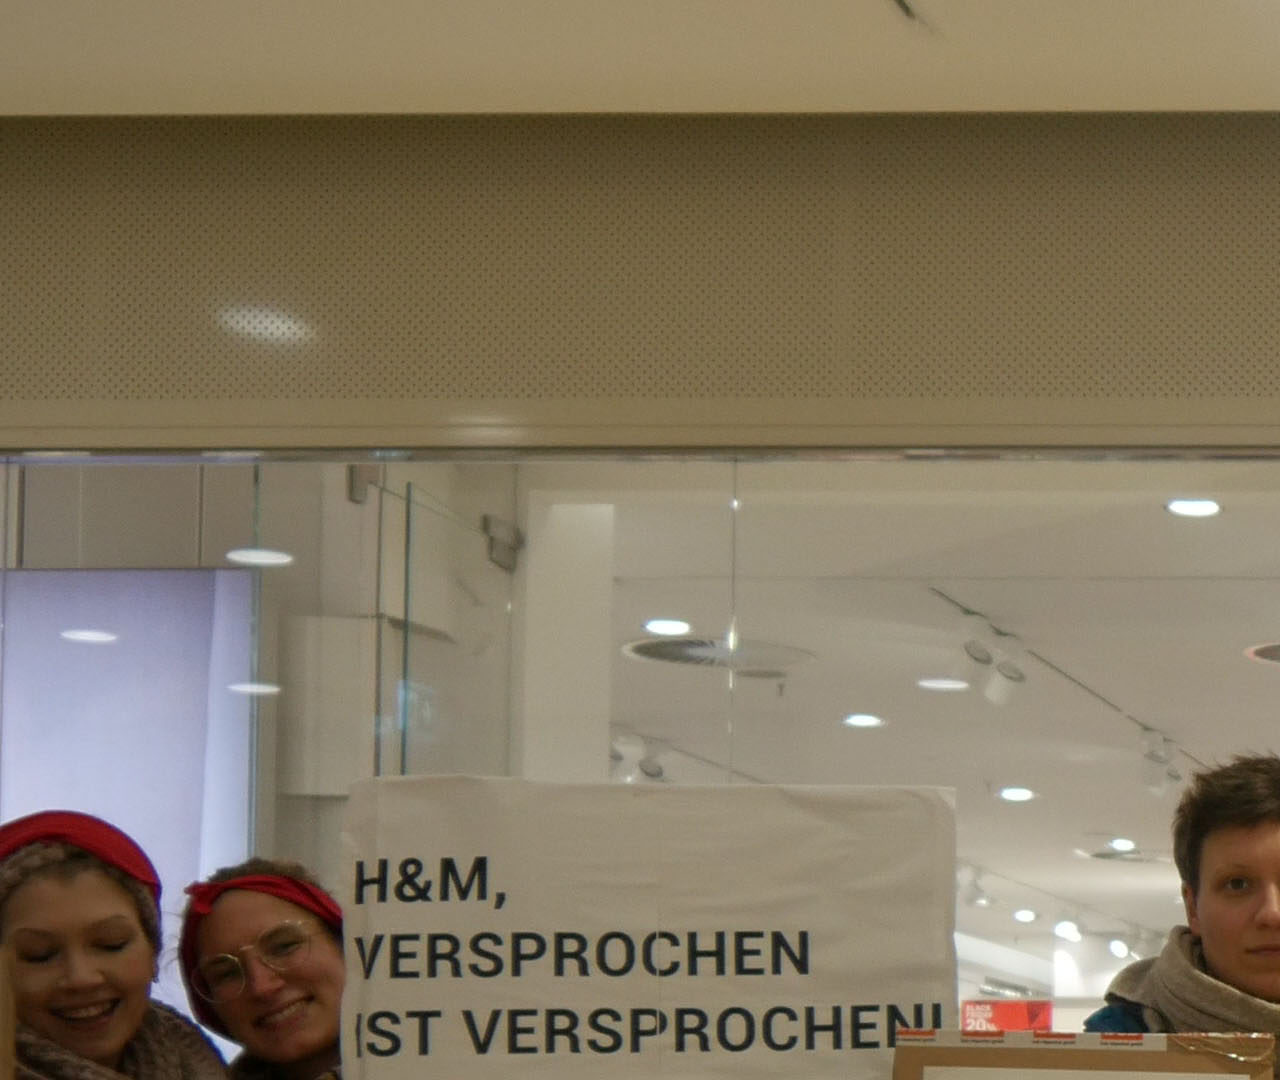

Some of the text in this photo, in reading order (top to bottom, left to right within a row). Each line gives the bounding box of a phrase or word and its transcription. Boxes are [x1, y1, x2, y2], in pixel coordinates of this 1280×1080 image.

[353, 856, 506, 910] H&M,
[354, 930, 810, 979] VERSPROCHEN
[354, 1010, 441, 1058] IST
